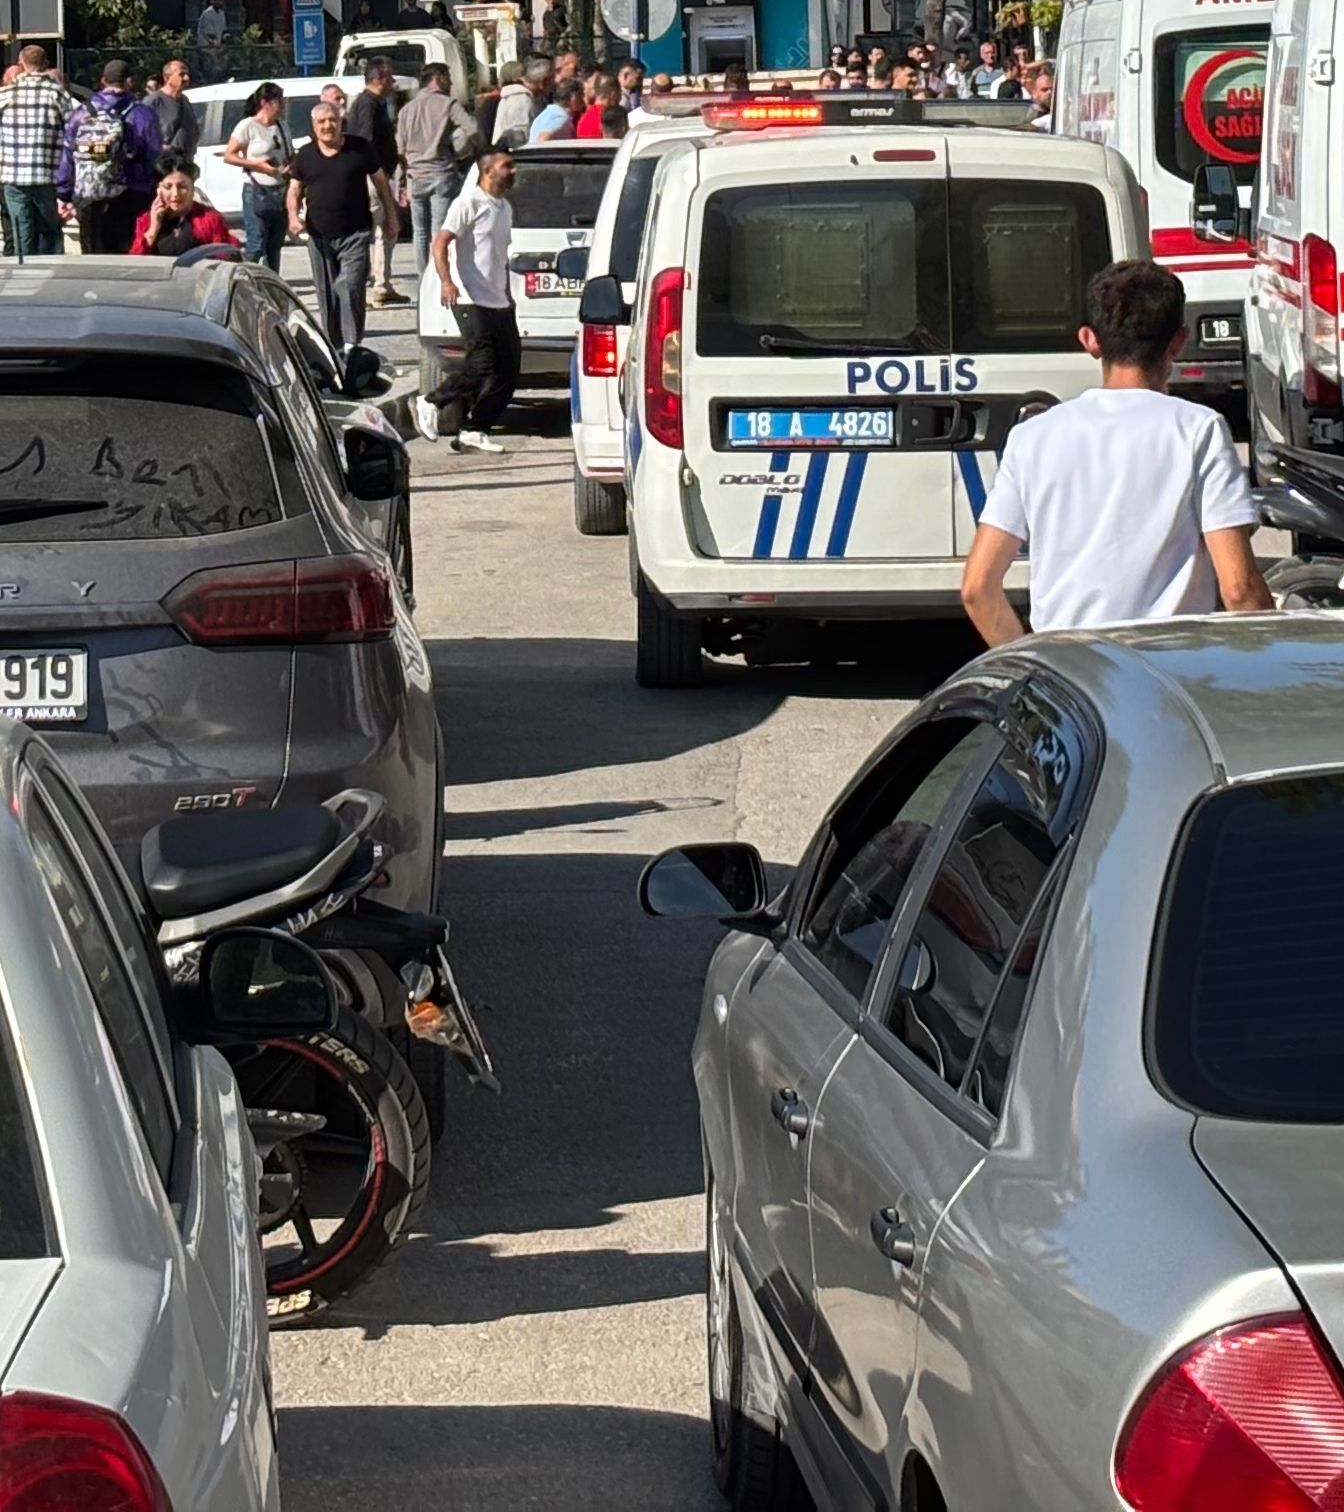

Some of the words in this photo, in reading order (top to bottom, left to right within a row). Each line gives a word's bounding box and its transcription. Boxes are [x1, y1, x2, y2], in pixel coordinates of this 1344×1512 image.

[535, 276, 551, 289] 18
[1213, 320, 1229, 337] 18
[748, 411, 771, 437] 18
[790, 411, 802, 437] A
[828, 411, 887, 437] 4826
[719, 474, 801, 486] DOBLO
[4, 654, 74, 700] 919
[26, 706, 77, 719] ANKARA
[174, 787, 257, 811] 290T
[299, 1032, 371, 1075] TERS
